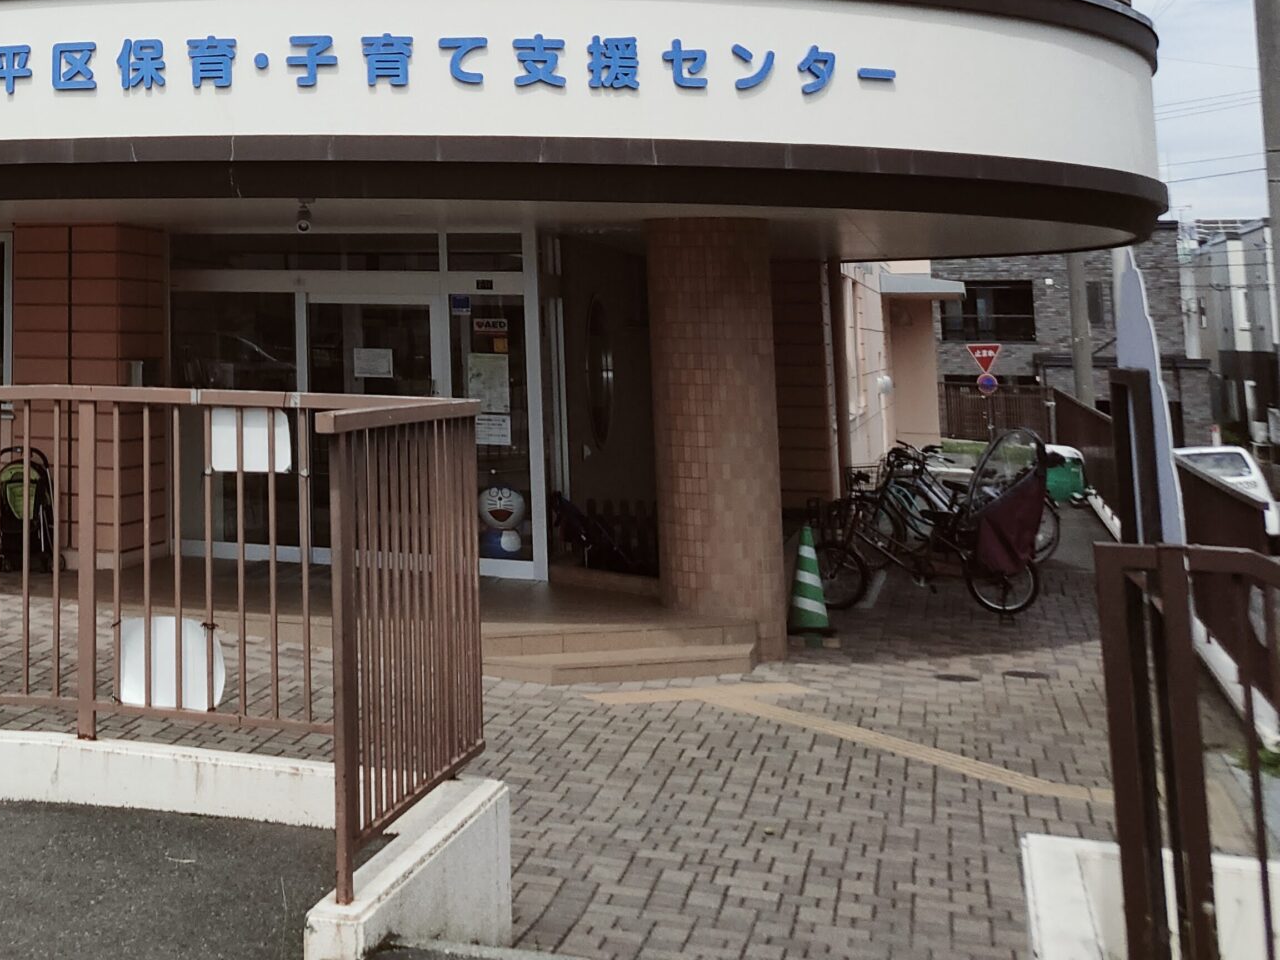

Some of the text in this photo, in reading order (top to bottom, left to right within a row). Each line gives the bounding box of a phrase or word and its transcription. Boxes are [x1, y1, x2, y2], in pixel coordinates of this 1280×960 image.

[485, 320, 506, 329] AED
[974, 349, 996, 357] 止まれ
